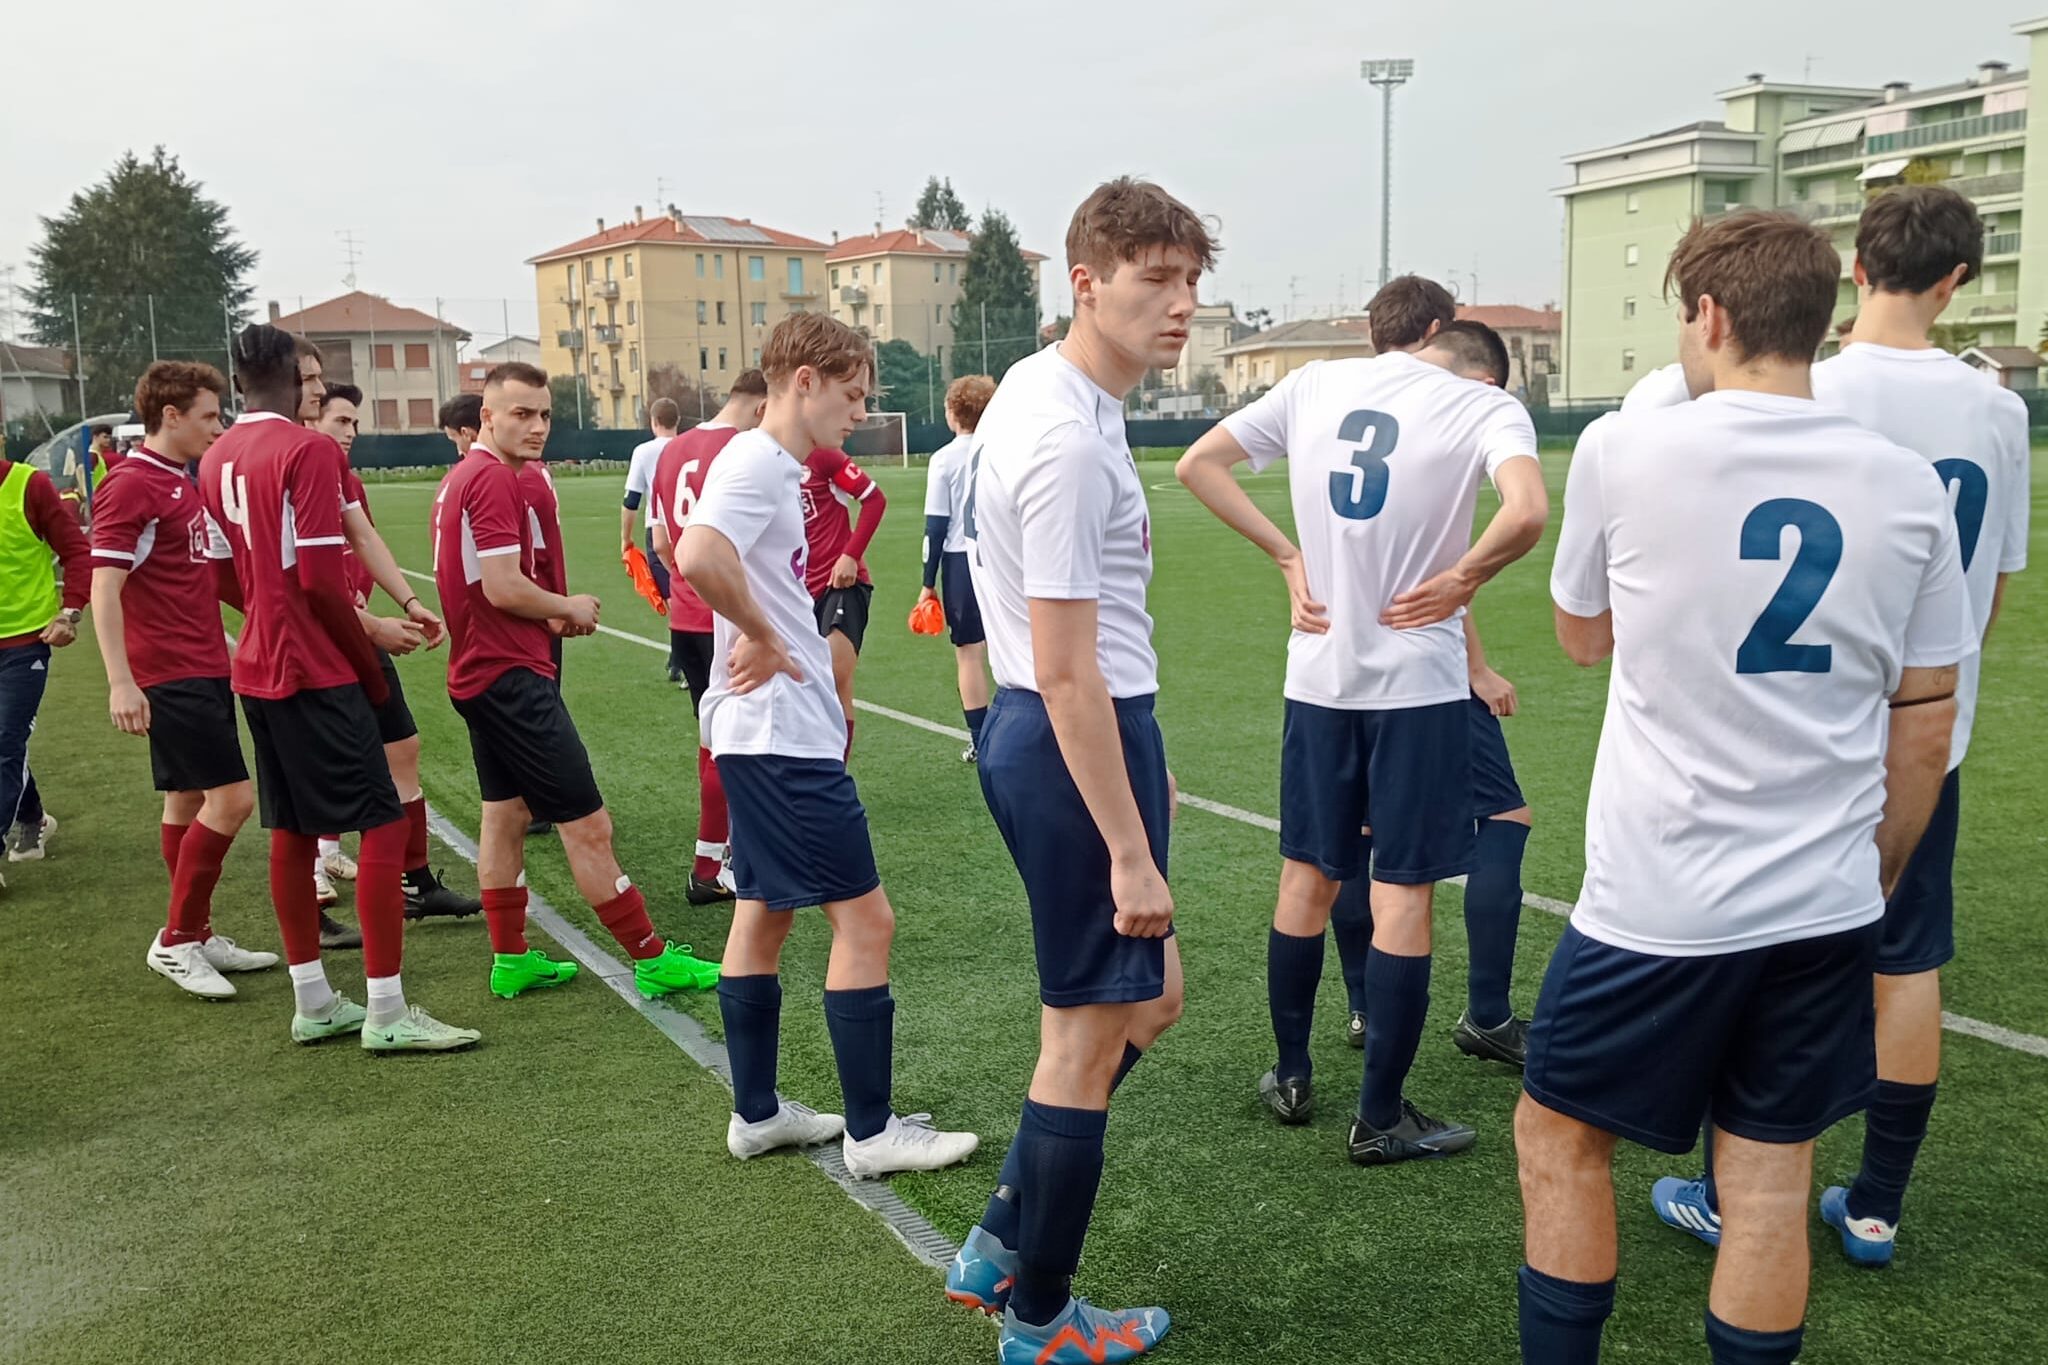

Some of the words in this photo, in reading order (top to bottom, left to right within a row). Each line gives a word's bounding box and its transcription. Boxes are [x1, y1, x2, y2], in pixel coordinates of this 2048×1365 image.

[221, 461, 252, 551] 4
[673, 459, 700, 528] 6
[1328, 409, 1400, 520] 3
[1735, 497, 1844, 674] 2
